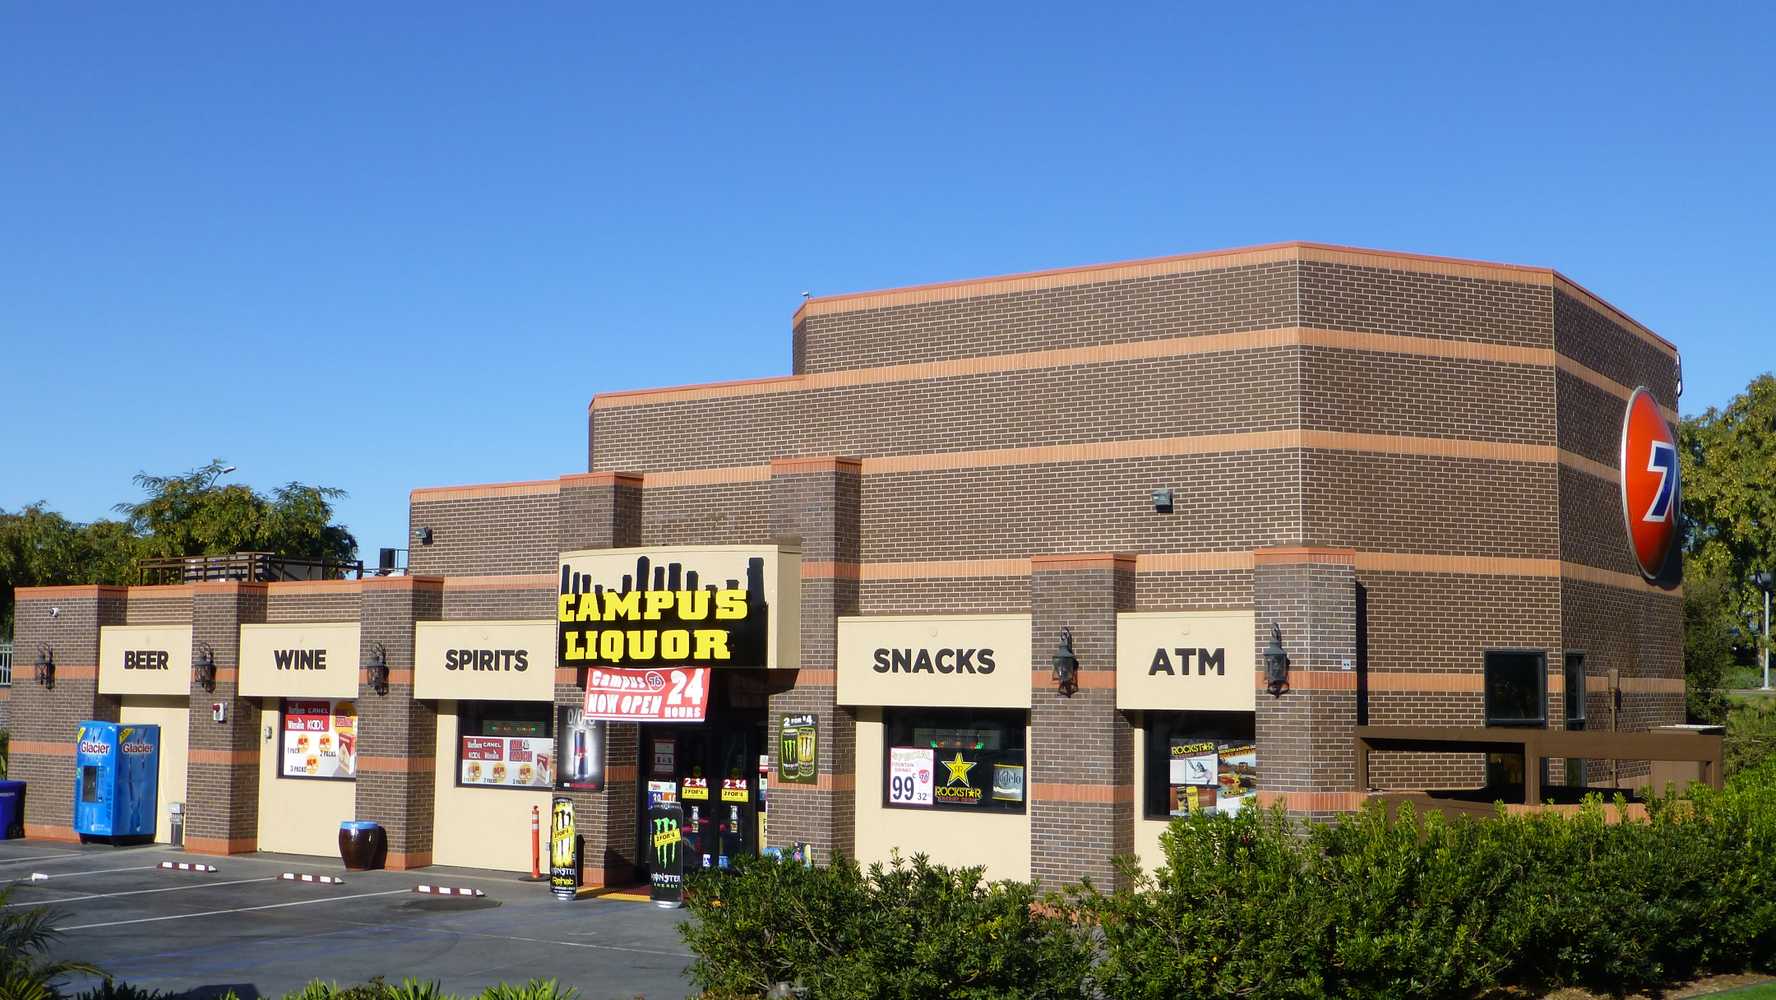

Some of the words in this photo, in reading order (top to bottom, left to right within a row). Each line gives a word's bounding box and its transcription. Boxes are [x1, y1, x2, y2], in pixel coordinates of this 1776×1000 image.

[559, 589, 748, 622] CAMPUS
[565, 629, 731, 663] LIQUOR
[124, 650, 169, 670] BEER
[273, 649, 327, 670] WINE
[445, 649, 529, 672] SPIRITS
[872, 648, 996, 675] SNACKS
[1148, 648, 1225, 675] ATM
[591, 671, 646, 689] Campus
[649, 676, 662, 687] 76
[666, 667, 705, 705] 24
[587, 693, 619, 714] NOW
[620, 695, 663, 714] OPEN
[664, 706, 702, 718] HOURS
[80, 741, 110, 754] Glacier
[122, 743, 153, 753] Glacier
[1171, 742, 1214, 755] ROCKSTAR
[935, 786, 983, 798] ROCKSTAR
